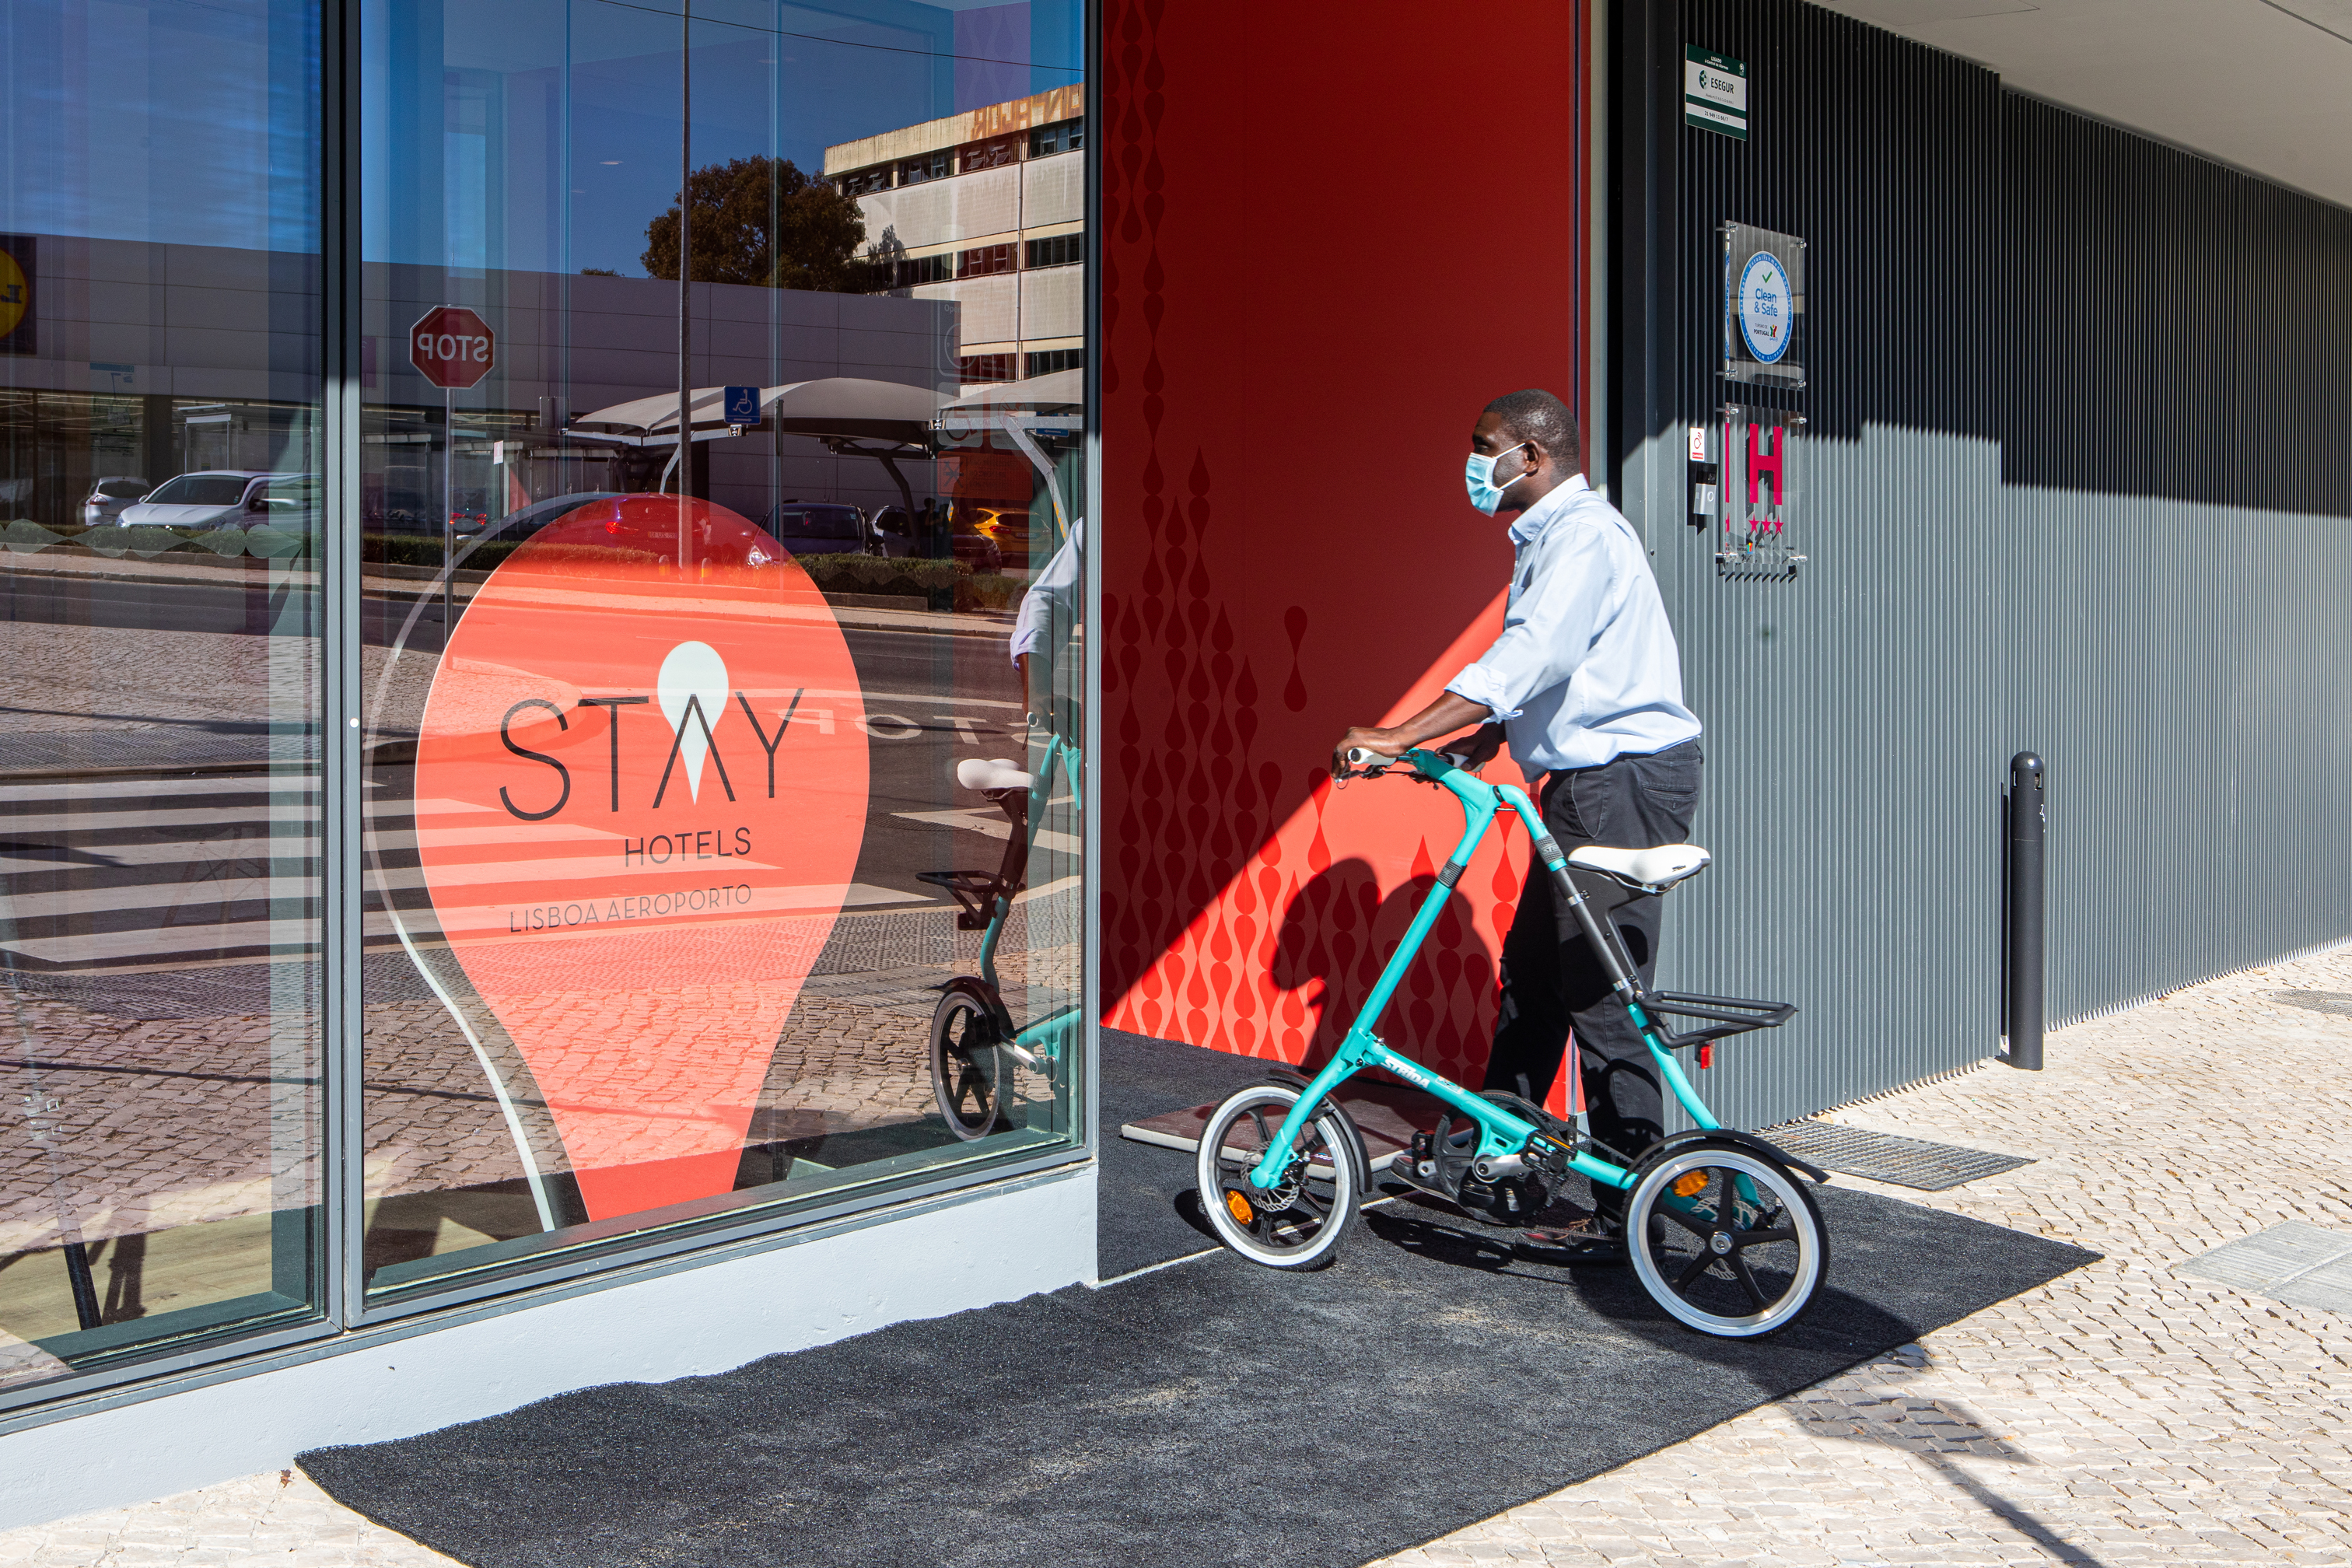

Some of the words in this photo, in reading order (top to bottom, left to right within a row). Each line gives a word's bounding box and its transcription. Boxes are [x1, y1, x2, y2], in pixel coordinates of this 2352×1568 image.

[1710, 78, 1734, 94] ESEGUR
[1748, 254, 1782, 274] Establishment
[1755, 288, 1777, 303] Clean
[1754, 301, 1760, 313] &
[1761, 303, 1778, 317] Safe
[1753, 328, 1769, 337] PORTUGAL
[1749, 423, 1783, 506] H
[499, 688, 805, 821] STAY
[625, 827, 751, 868] HOTELS
[509, 901, 600, 933] LISBOA
[606, 884, 752, 922] AEROPORTO
